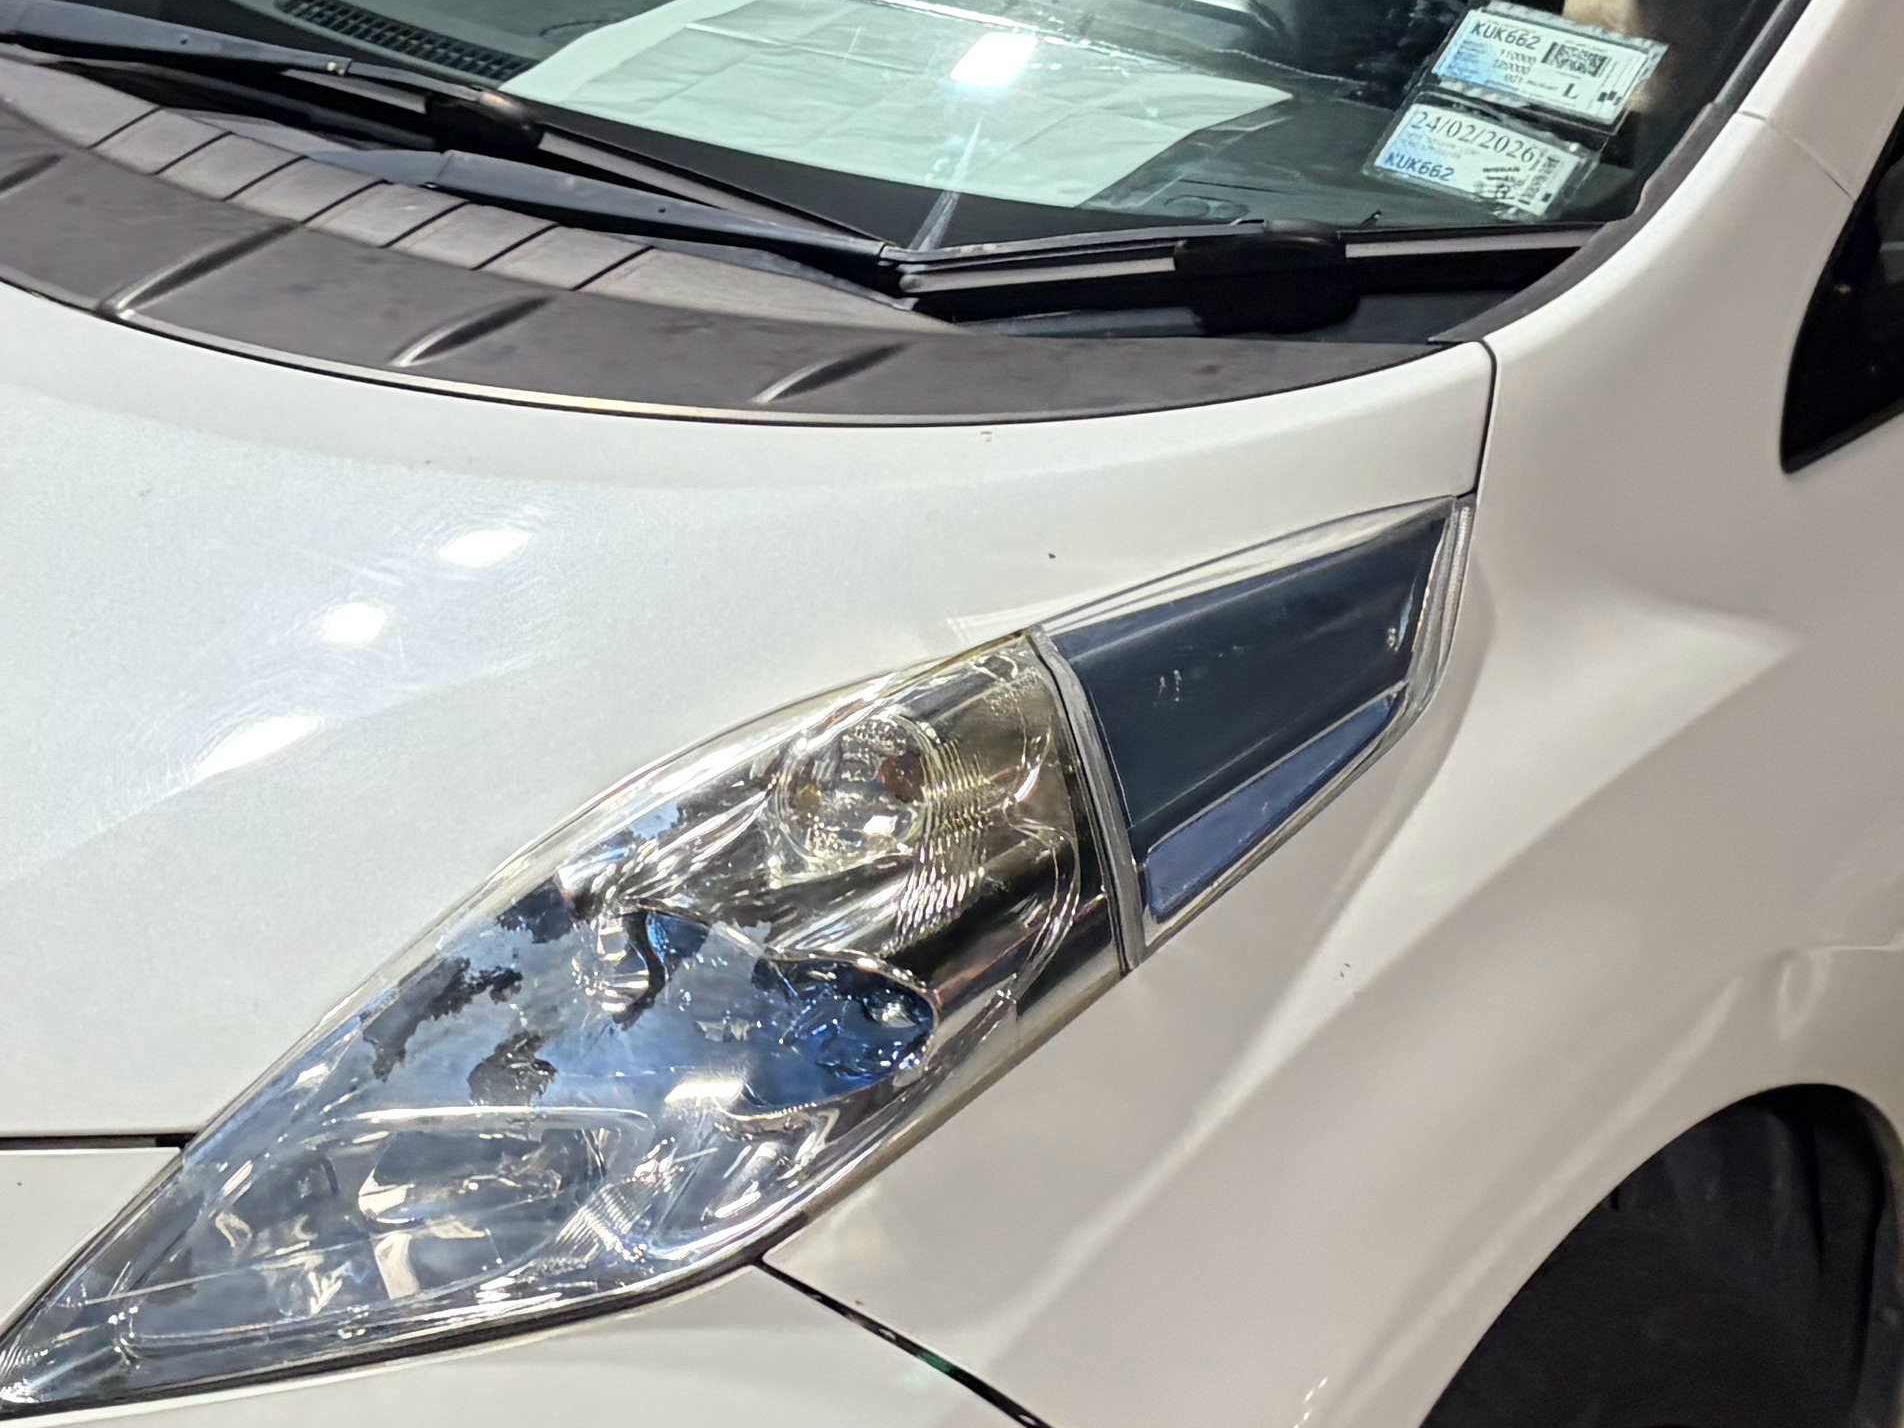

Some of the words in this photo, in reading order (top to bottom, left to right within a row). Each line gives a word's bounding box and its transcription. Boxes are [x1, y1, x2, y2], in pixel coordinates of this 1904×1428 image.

[1470, 20, 1542, 51] KUK662
[1410, 110, 1535, 163] 24/02/2026
[1384, 152, 1456, 182] KUK662
